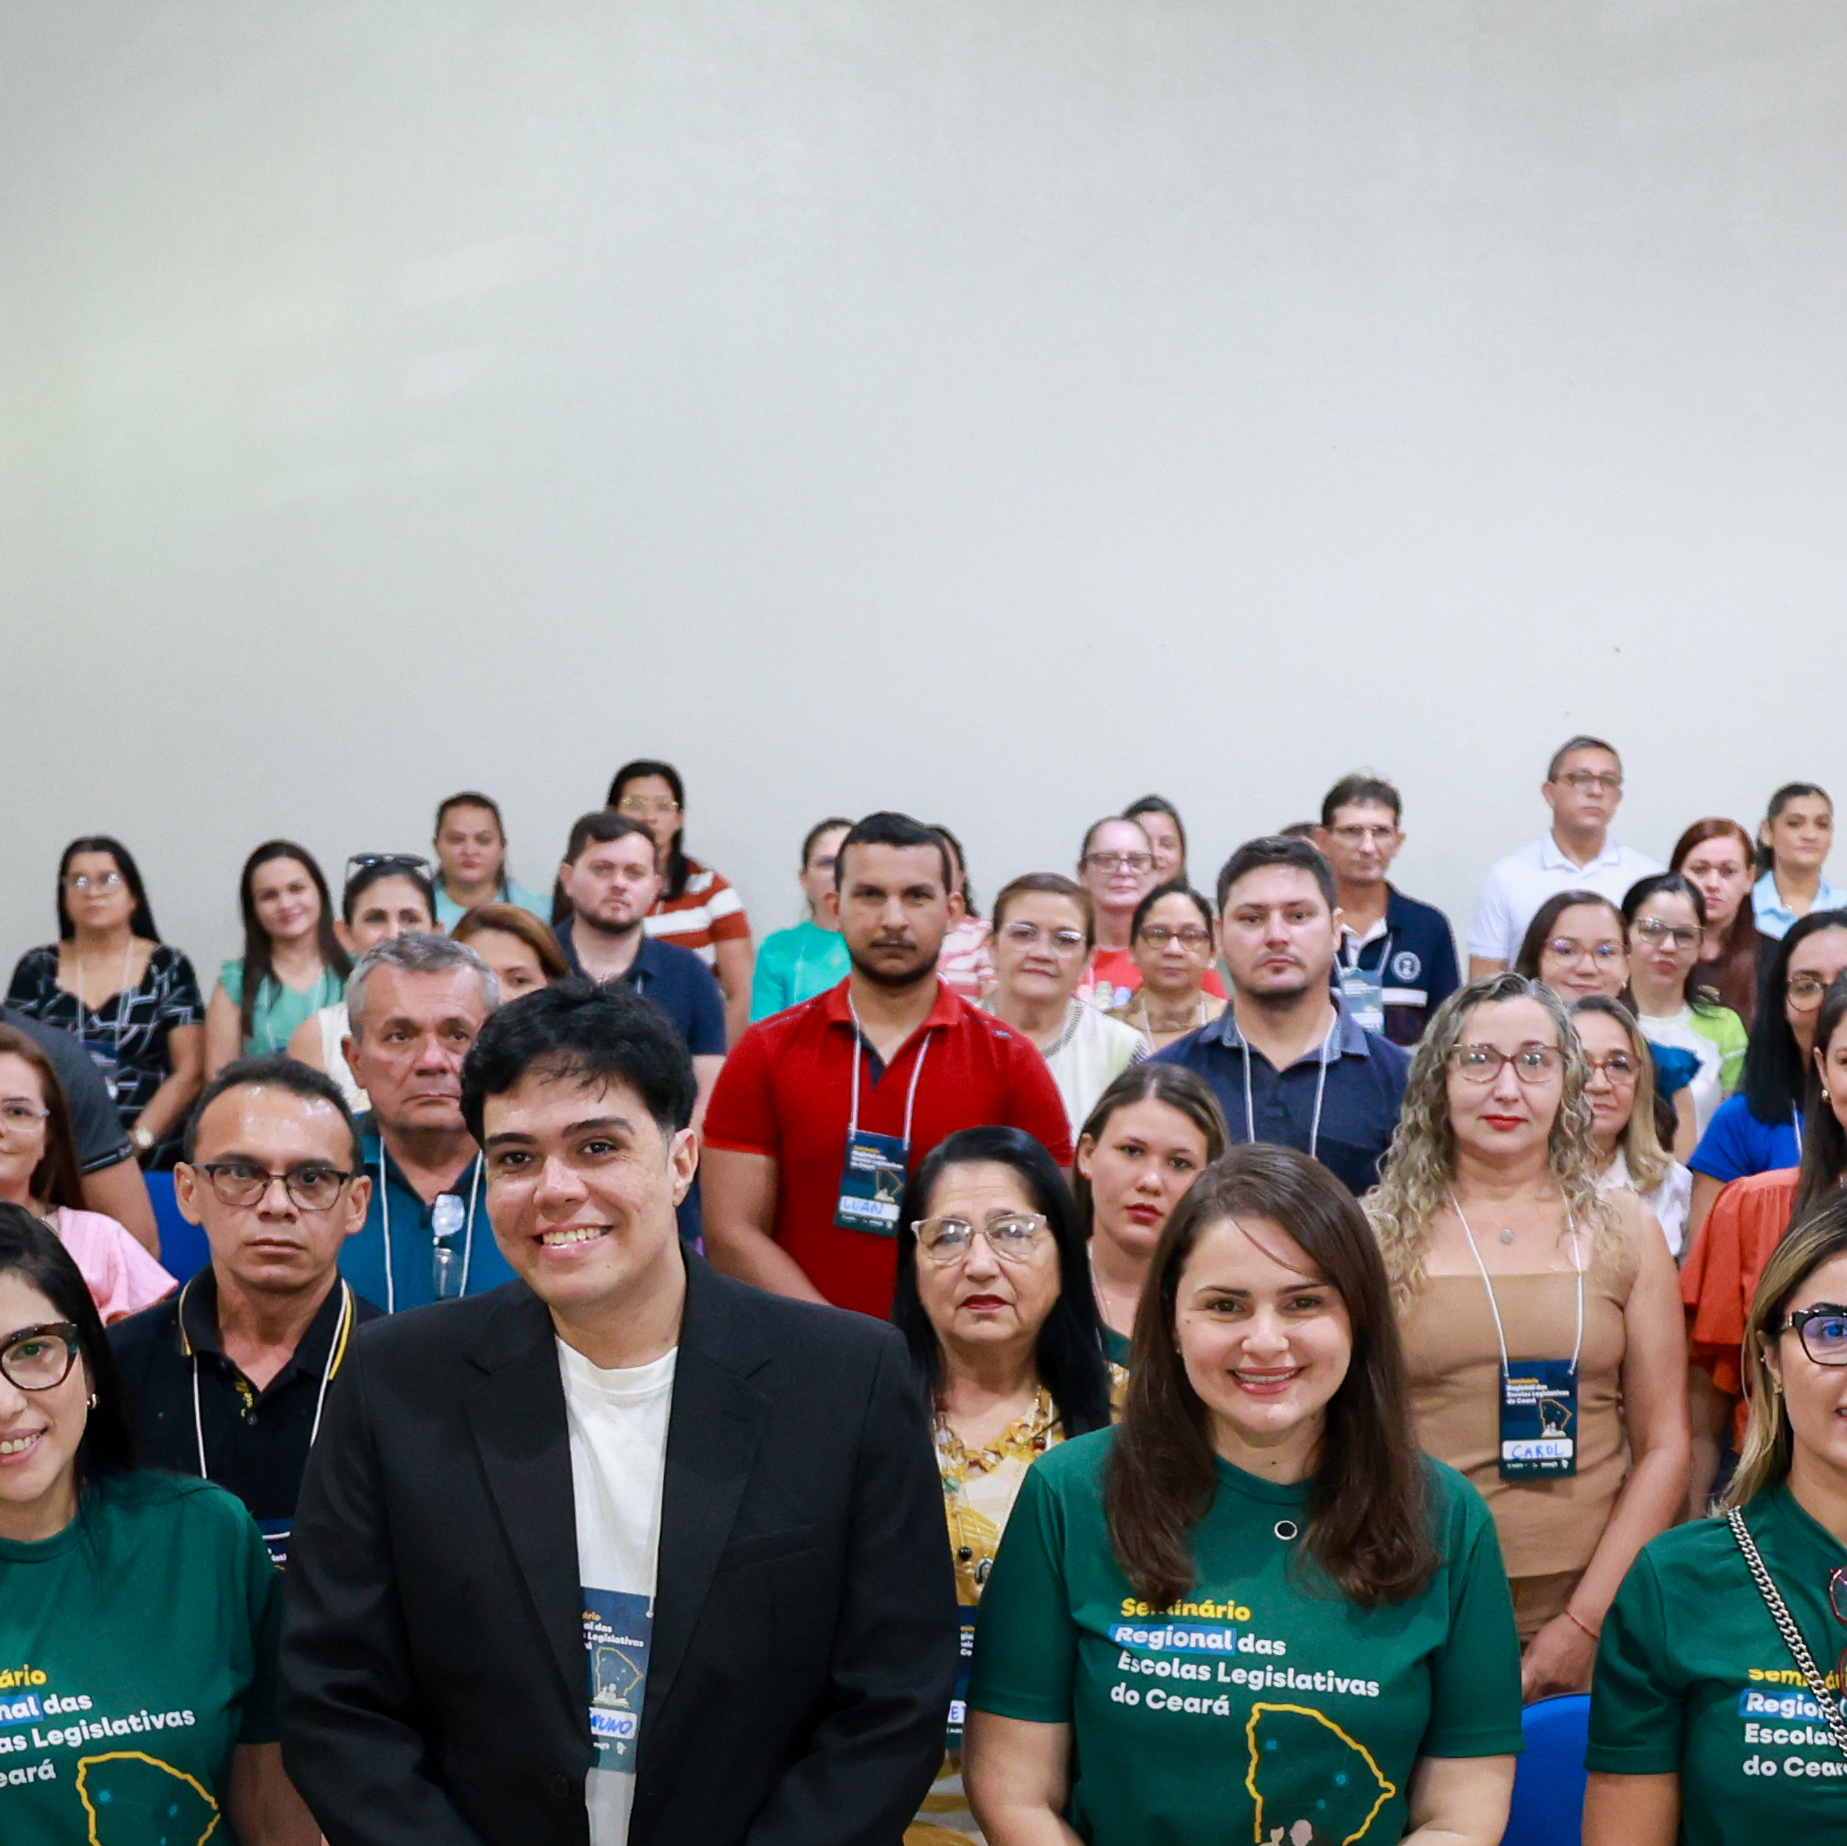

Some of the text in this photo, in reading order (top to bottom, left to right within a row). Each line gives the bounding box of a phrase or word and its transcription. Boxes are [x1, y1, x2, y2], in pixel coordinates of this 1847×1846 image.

[1512, 1443, 1564, 1459] CAROL
[1120, 1597, 1251, 1621] Seinário
[1115, 1625, 1286, 1656] Regional das
[1118, 1650, 1380, 1697] Escolas Legislativas
[43, 1693, 93, 1715] das
[1110, 1682, 1230, 1716] do Ceará
[32, 1709, 196, 1748] Legislativas
[1744, 1723, 1837, 1747] Escolas
[1742, 1755, 1778, 1777] do
